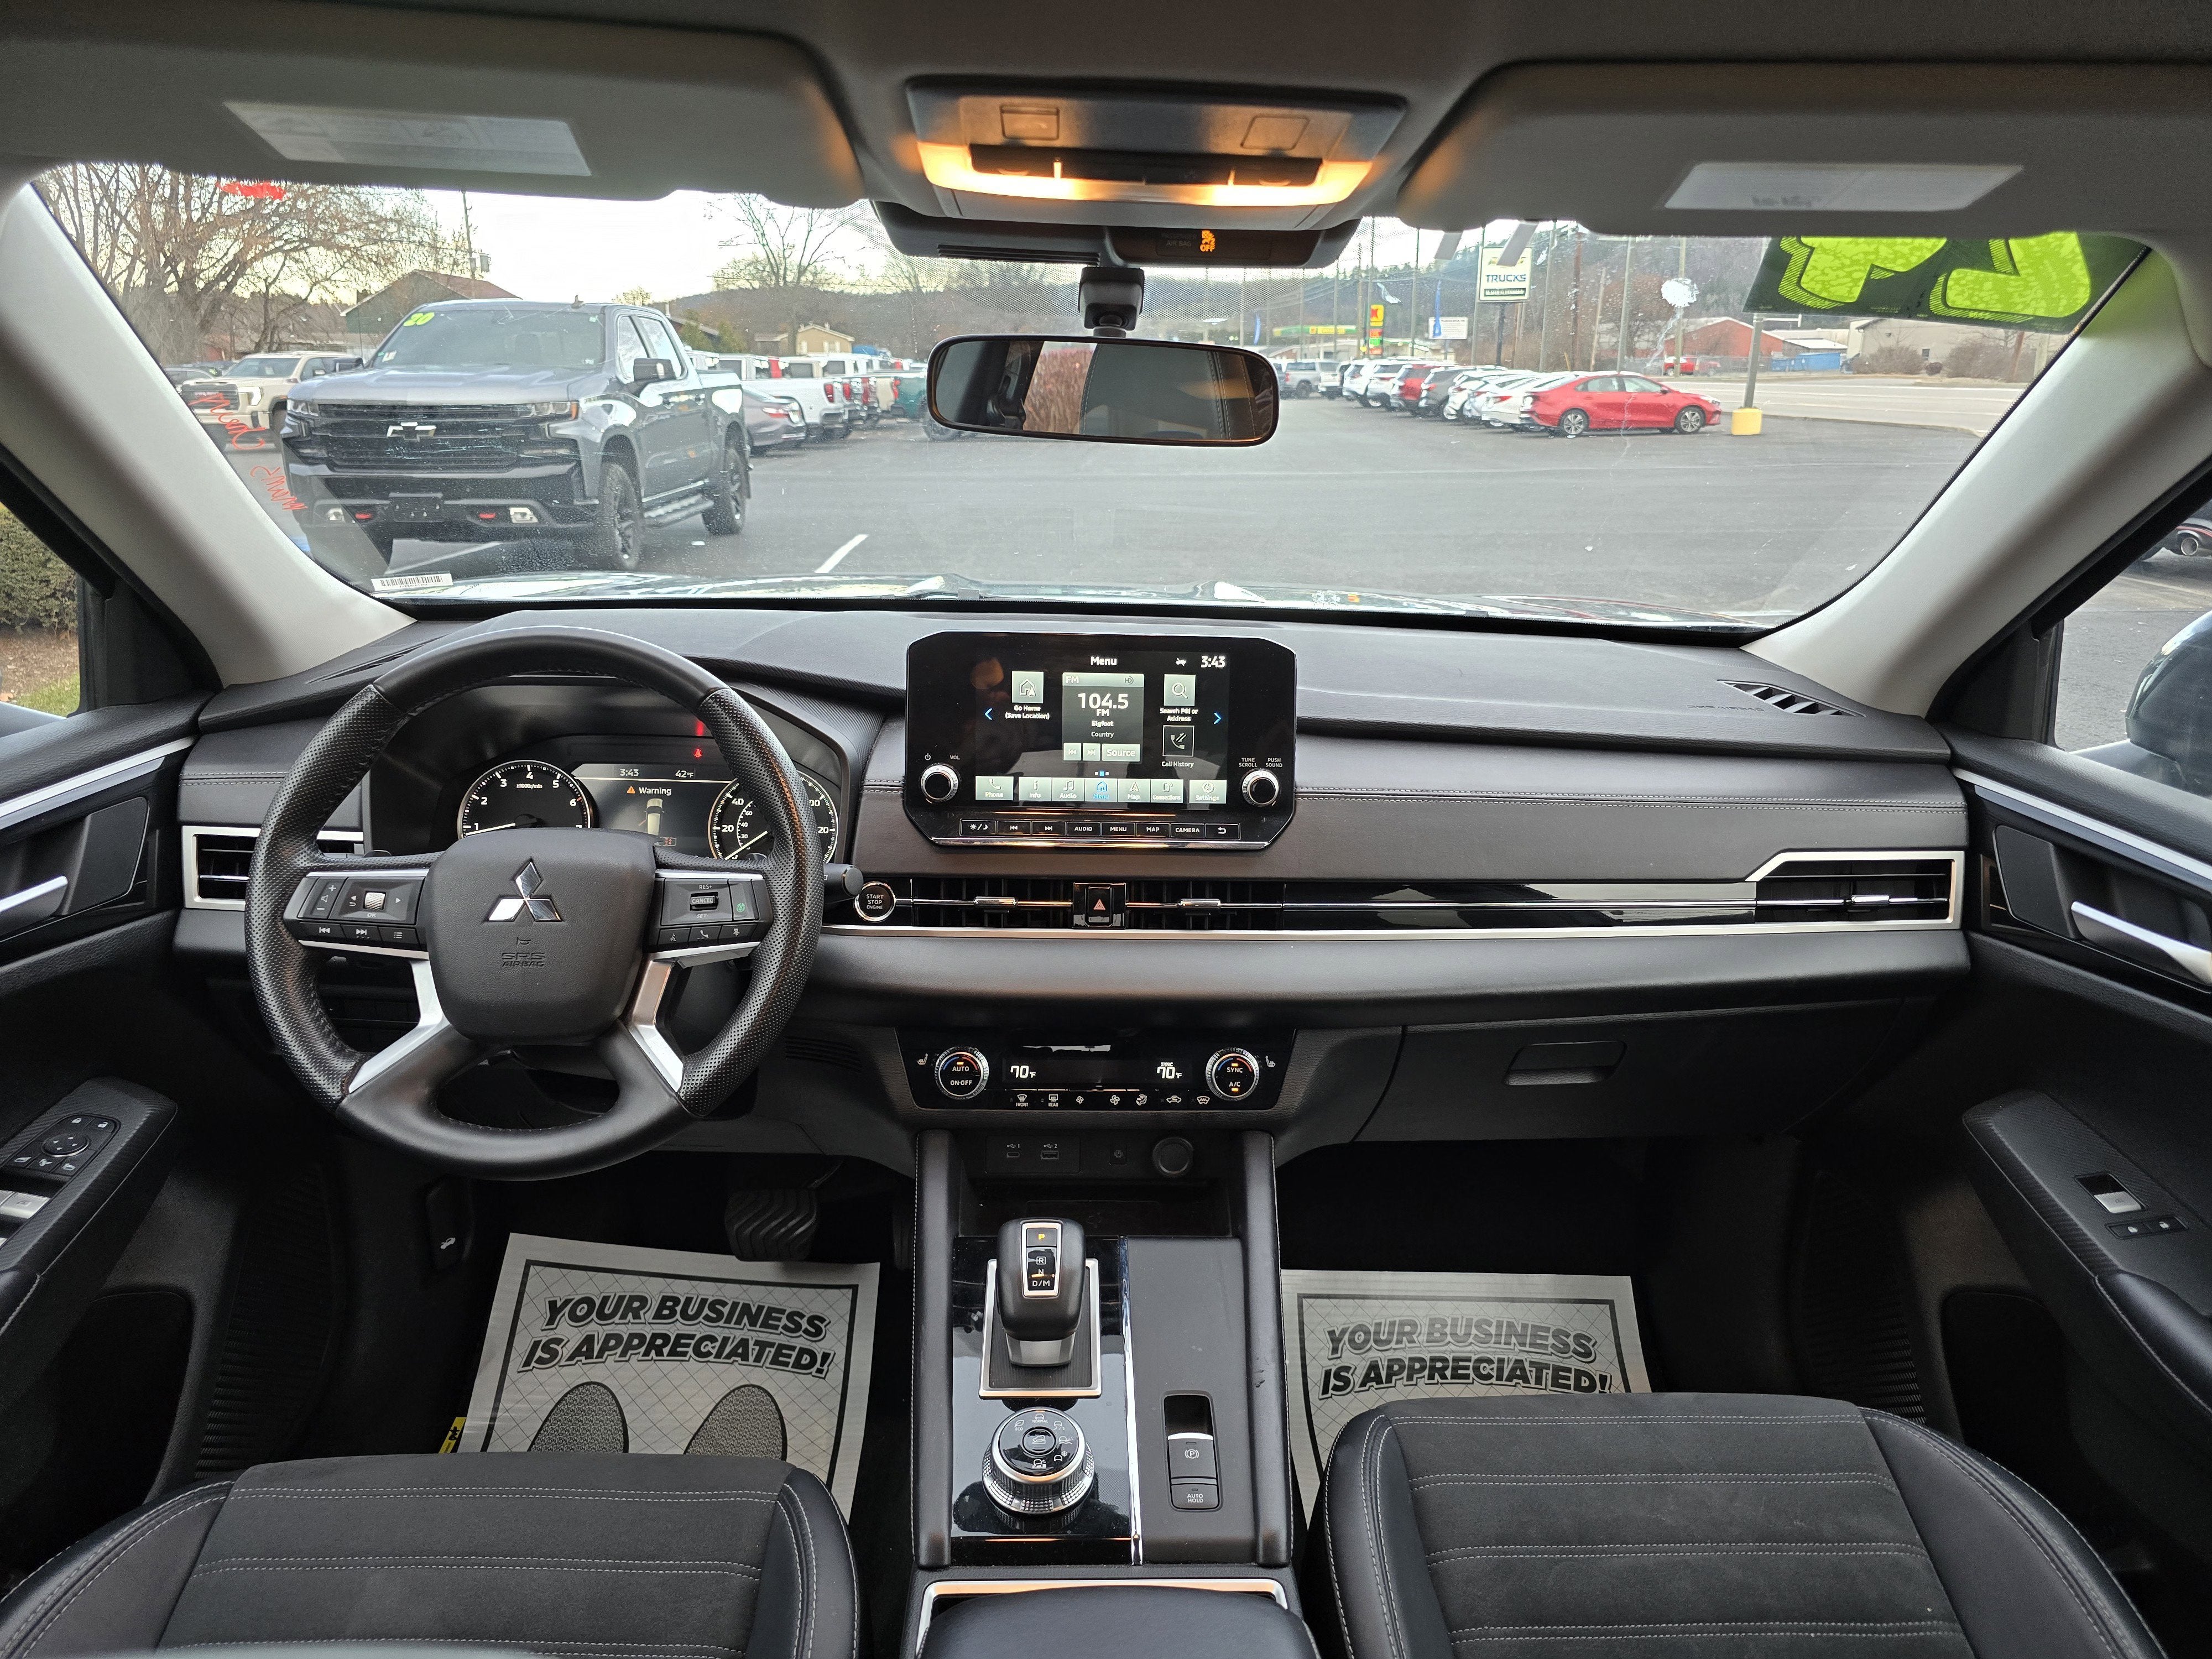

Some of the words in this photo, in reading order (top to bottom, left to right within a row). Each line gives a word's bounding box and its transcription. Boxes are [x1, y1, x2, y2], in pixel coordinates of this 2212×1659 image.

[1485, 274, 1526, 283] TRUCKS
[403, 312, 435, 327] 20
[1091, 656, 1118, 666] Menu
[1201, 655, 1225, 668] 3:43
[1065, 675, 1079, 684] FM
[1078, 692, 1129, 709] 104.5
[1107, 749, 1136, 757] Source
[526, 771, 533, 780] 4
[619, 768, 639, 776] 3:43
[500, 779, 507, 787] 3
[639, 787, 672, 796] Warning
[481, 797, 488, 805] 2
[542, 1292, 651, 1330] YOUR
[651, 1294, 831, 1340] BUSINESS
[1326, 1318, 1421, 1359] YOUR
[1425, 1315, 1597, 1363] BUSINESS
[519, 1335, 568, 1371] IS
[564, 1331, 835, 1378] APPRECIATED!
[1319, 1364, 1355, 1400] IS
[1357, 1354, 1611, 1394] APPRECIATED!
